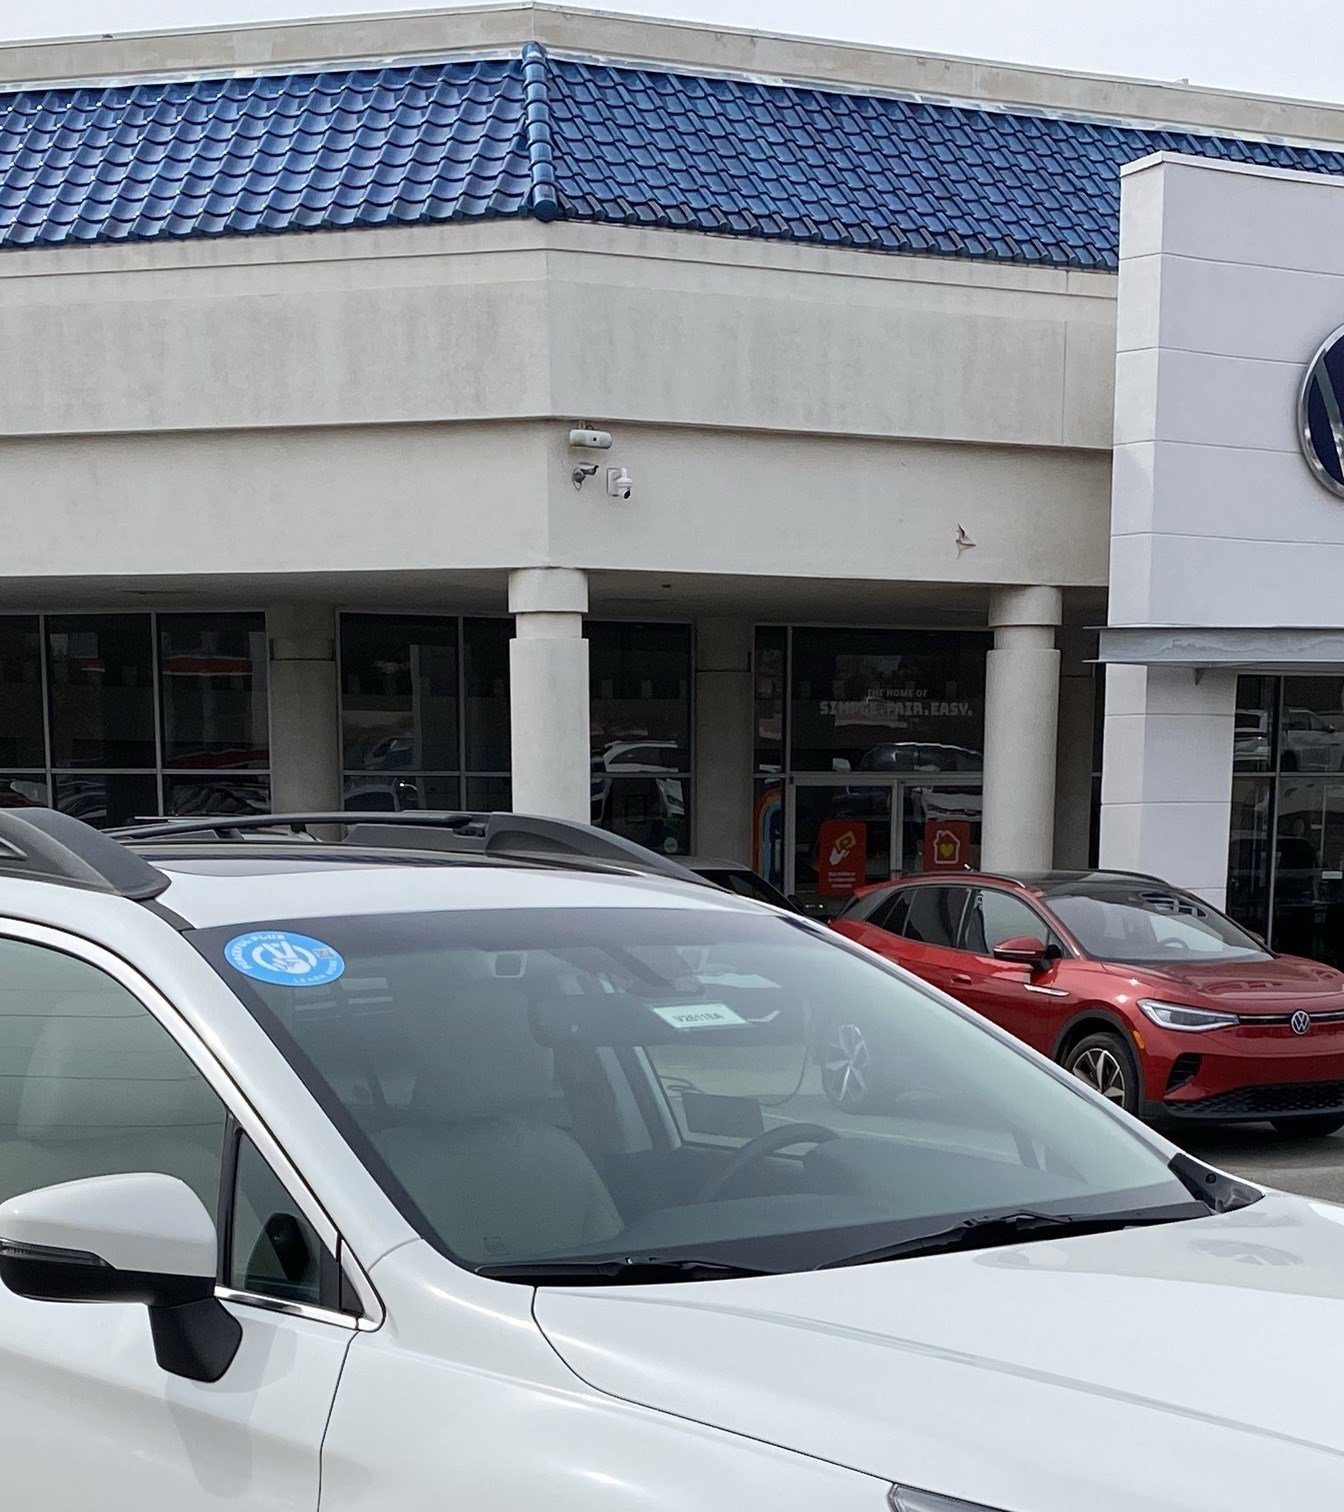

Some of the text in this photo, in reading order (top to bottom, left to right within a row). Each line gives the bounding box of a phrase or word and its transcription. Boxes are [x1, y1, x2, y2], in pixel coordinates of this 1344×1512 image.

[867, 688, 928, 698] THE HOME OF
[1290, 1010, 1311, 1035] VW
